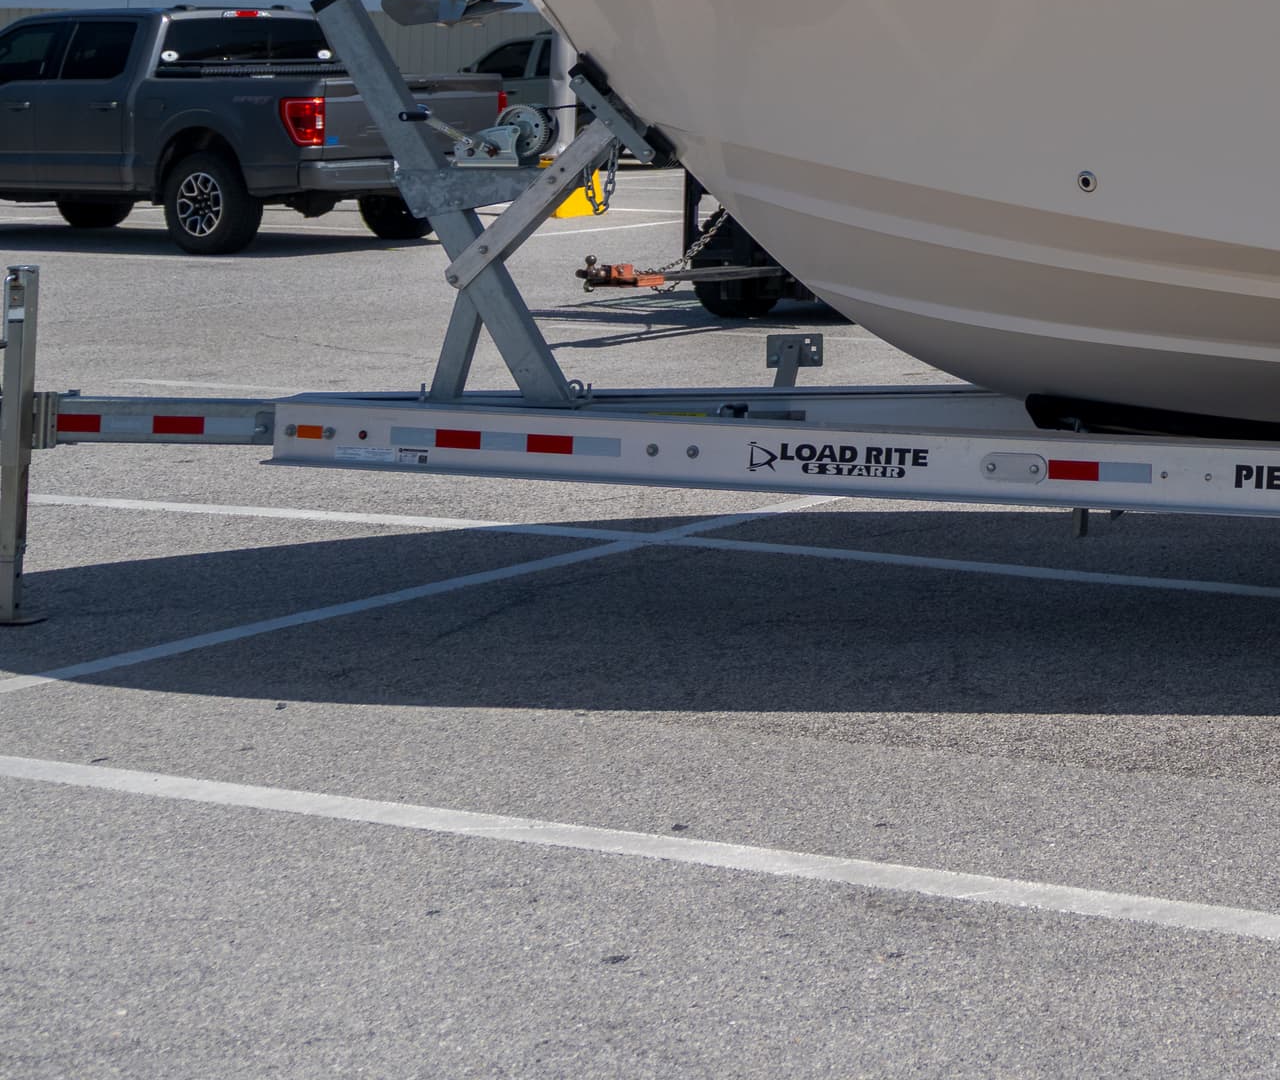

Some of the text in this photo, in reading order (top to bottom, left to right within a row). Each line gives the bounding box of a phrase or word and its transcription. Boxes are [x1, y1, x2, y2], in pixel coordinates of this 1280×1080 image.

[780, 443, 929, 467] LOAD RITE
[807, 463, 901, 477] 5 STARR
